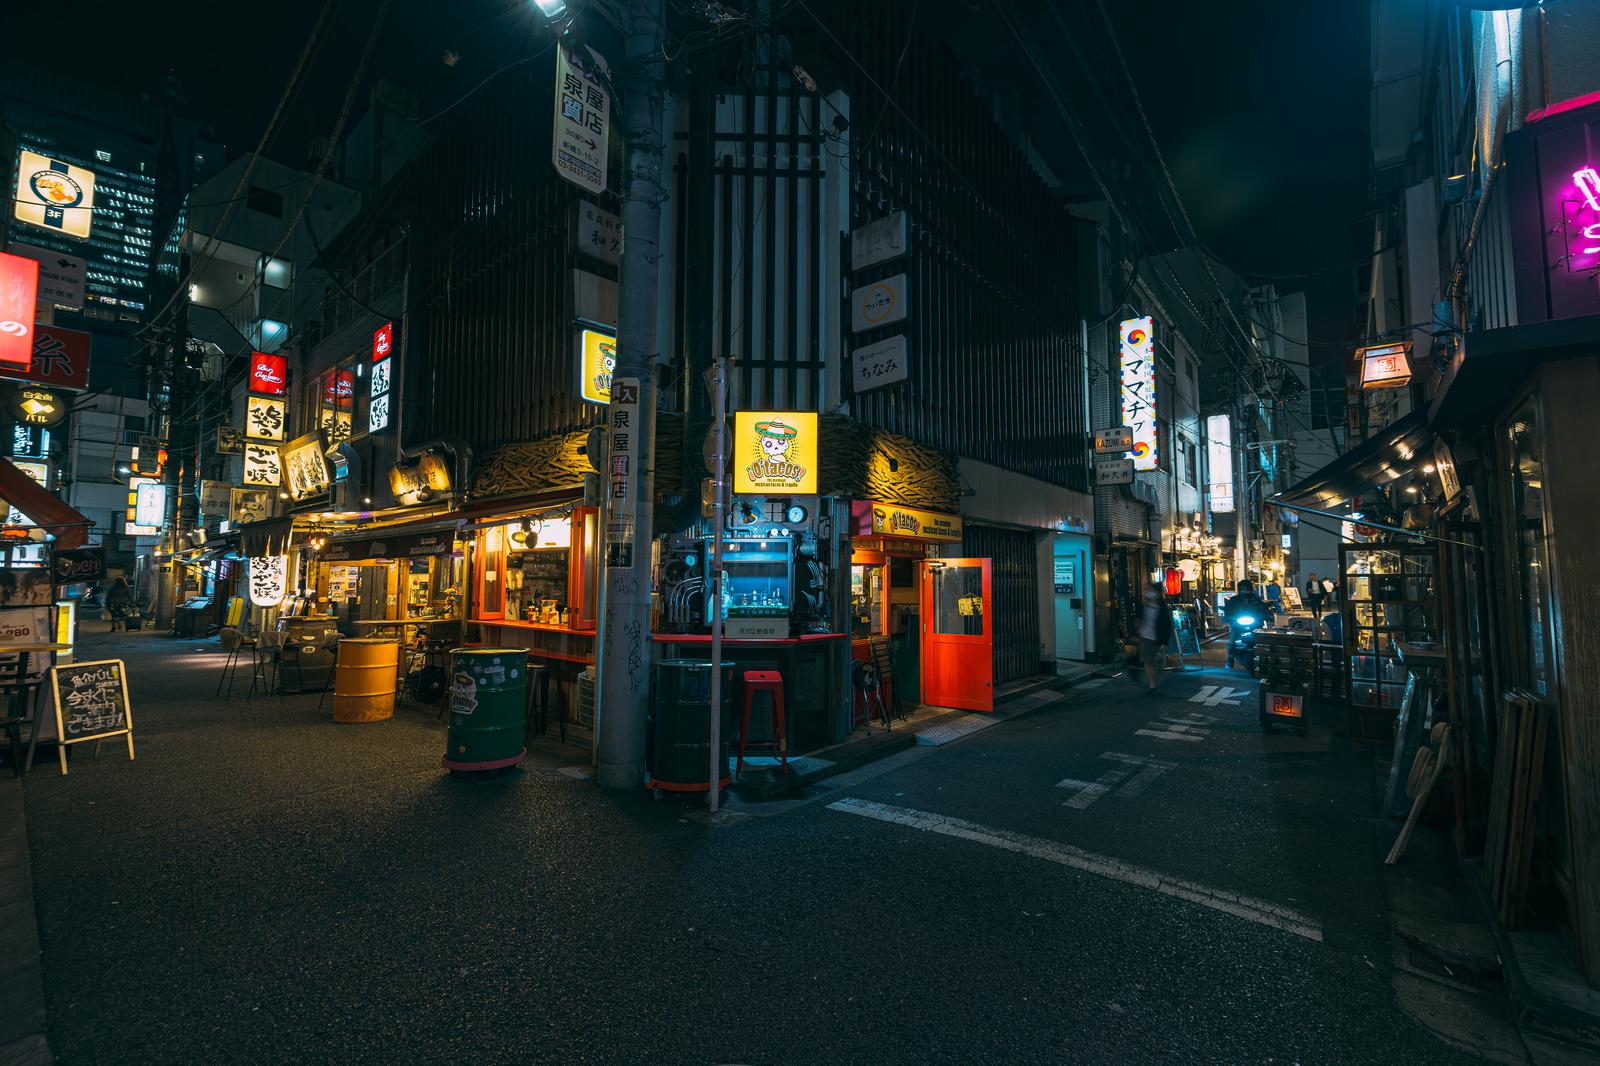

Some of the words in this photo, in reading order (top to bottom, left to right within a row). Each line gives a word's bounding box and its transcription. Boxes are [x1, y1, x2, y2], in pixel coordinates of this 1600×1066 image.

[563, 72, 604, 113] 泉屋
[562, 92, 603, 136] 質店
[47, 209, 62, 219] 3F
[860, 358, 898, 380] ちなみ
[25, 413, 48, 423] バル
[611, 410, 630, 499] 泉屋質店
[1096, 438, 1120, 449] KAZUMI
